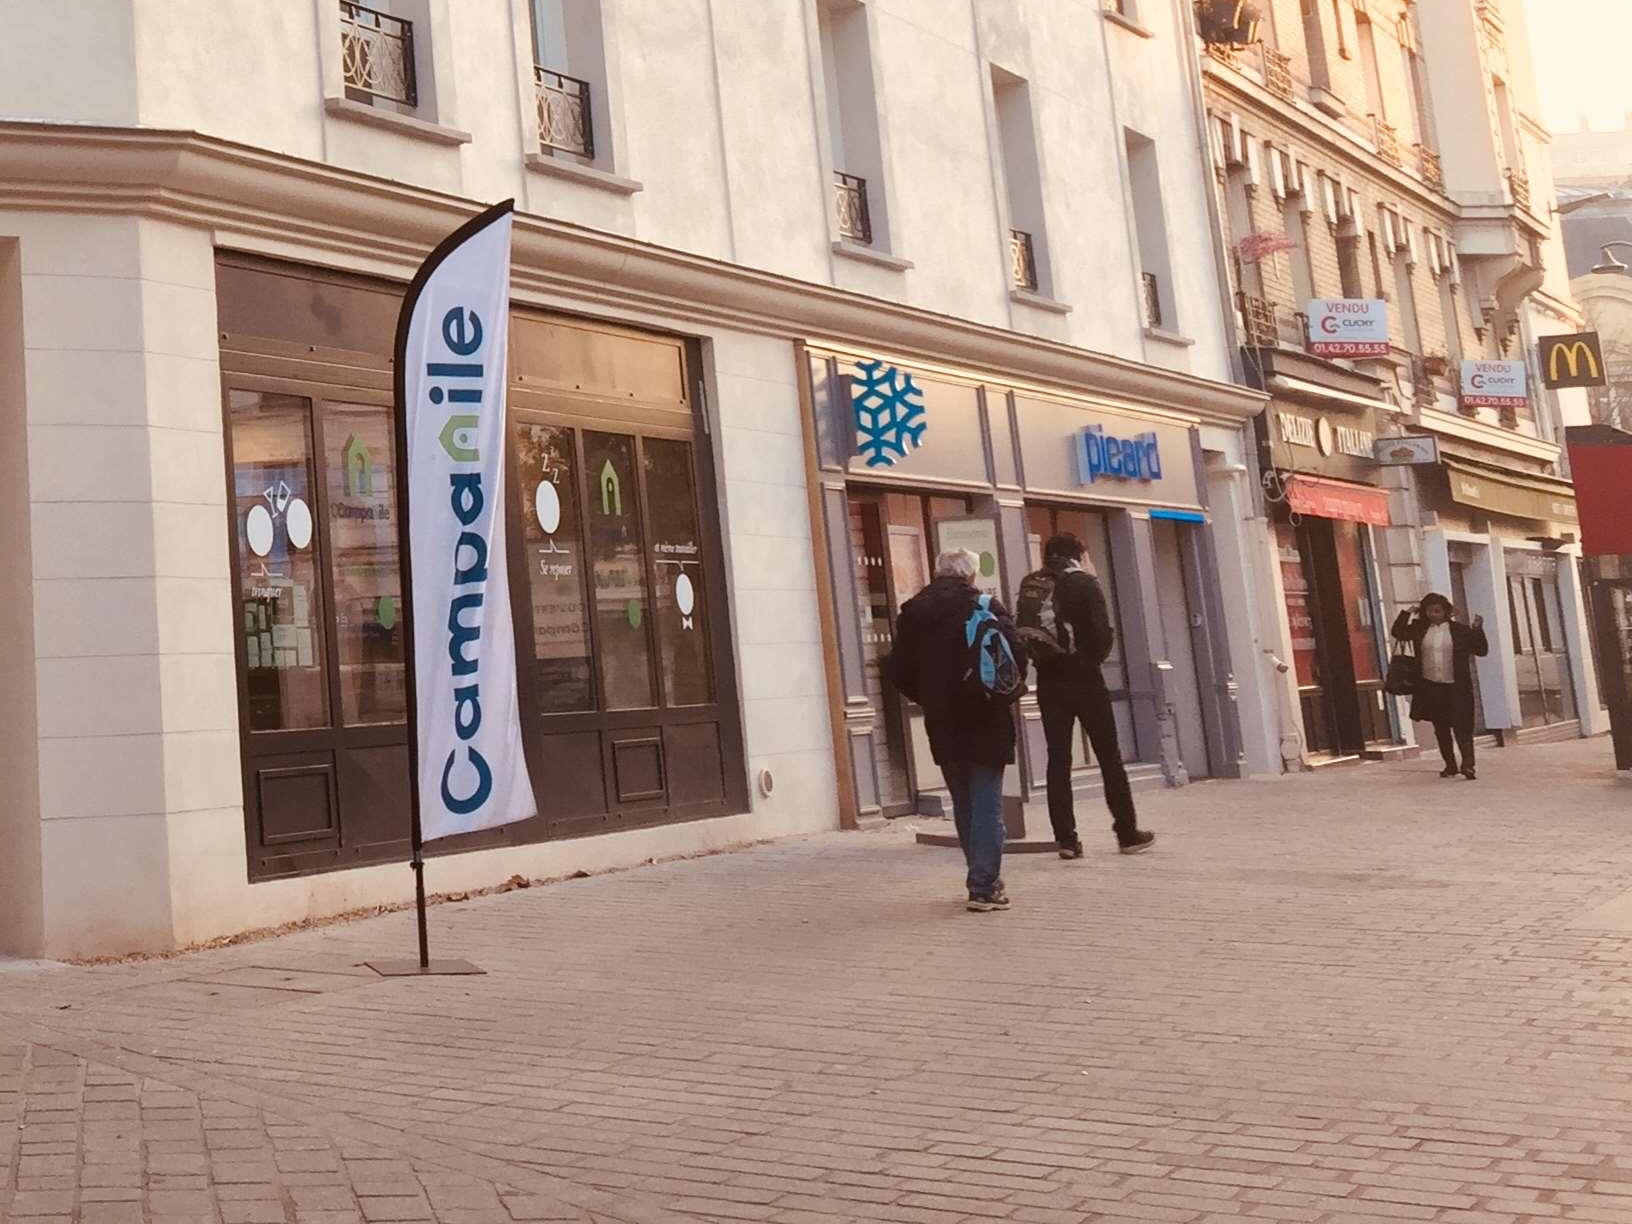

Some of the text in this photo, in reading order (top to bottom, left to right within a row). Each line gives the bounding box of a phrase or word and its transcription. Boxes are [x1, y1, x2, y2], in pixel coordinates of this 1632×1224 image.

[1326, 303, 1369, 314] VENDU
[1475, 363, 1511, 373] VENDU
[427, 305, 493, 815] Campanile
